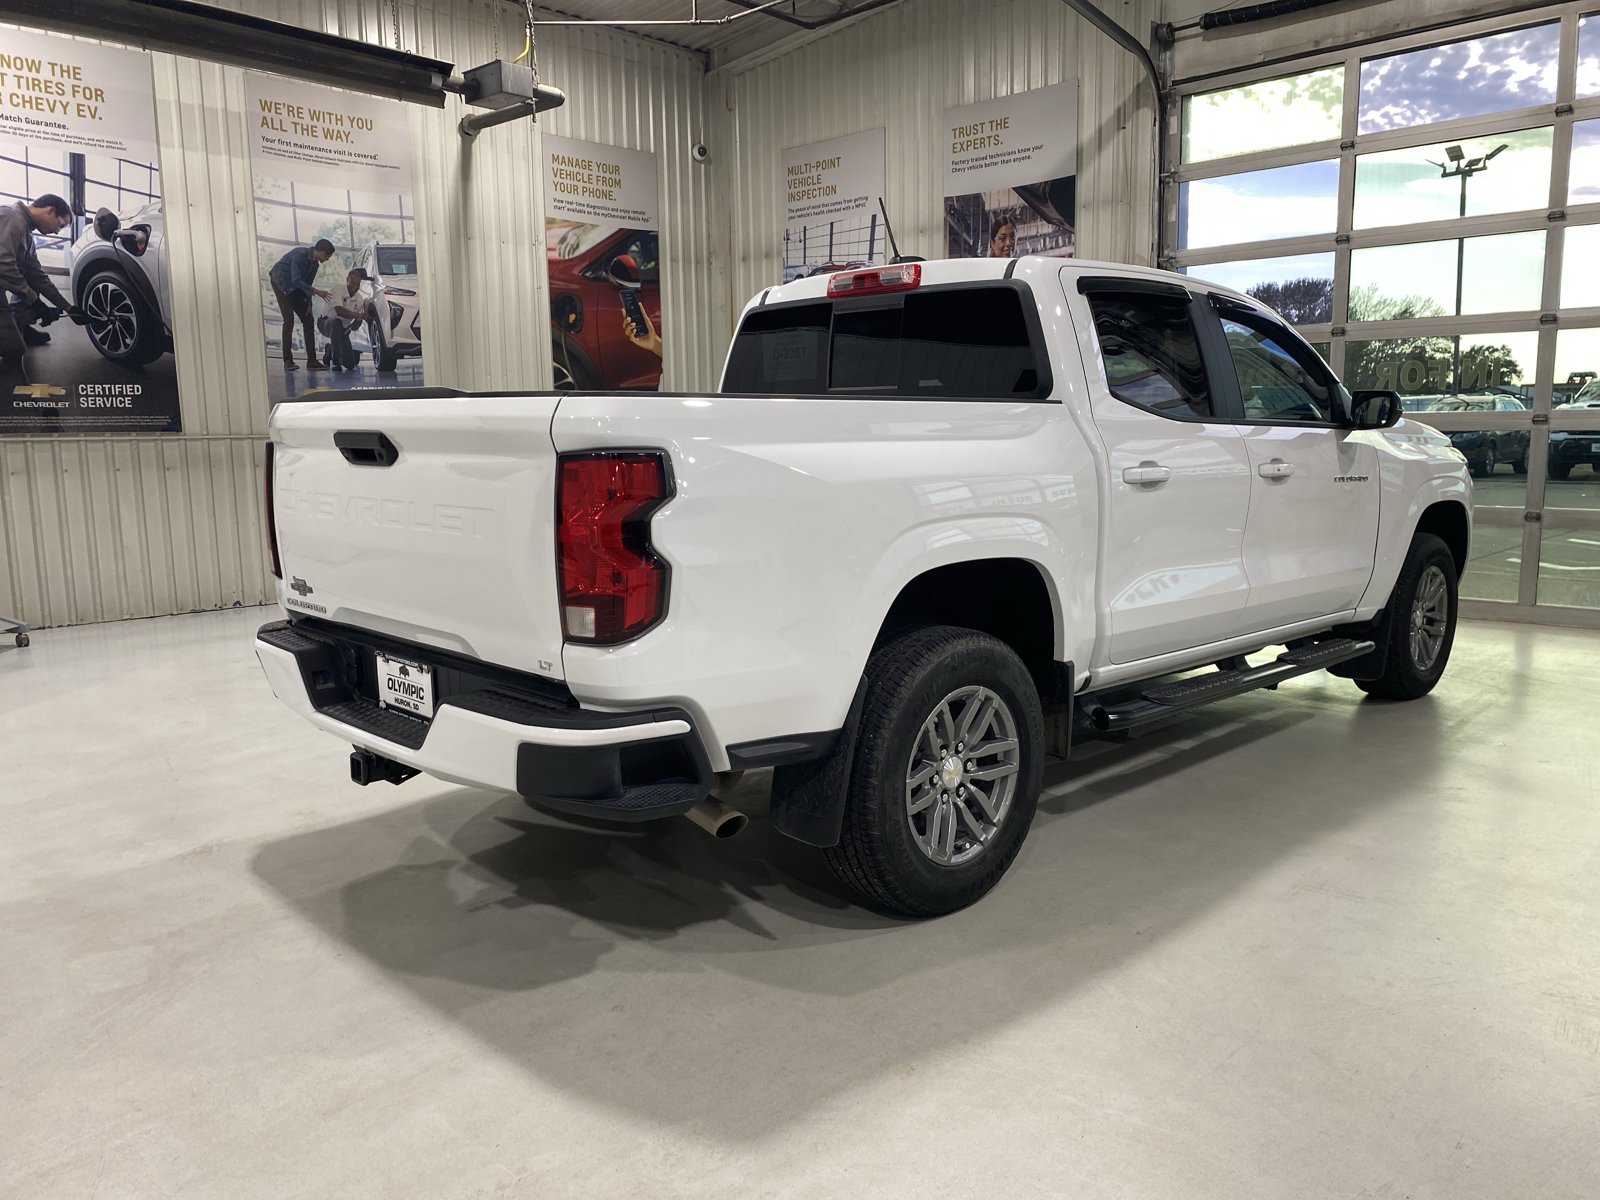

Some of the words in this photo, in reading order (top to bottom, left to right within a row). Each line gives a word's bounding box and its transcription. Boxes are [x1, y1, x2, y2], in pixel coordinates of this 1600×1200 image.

[0, 54, 41, 74] NOW
[48, 62, 82, 81] THE
[13, 75, 65, 96] TIRES
[71, 84, 105, 103] FOR
[9, 92, 69, 115] CHEVY
[76, 103, 103, 121] EV.
[259, 99, 304, 120] WE'RE
[308, 108, 344, 127] WITH
[347, 115, 373, 131] YOU
[25, 117, 69, 130] Guarantee.
[260, 116, 288, 132] ALL
[291, 121, 318, 138] THE
[322, 127, 354, 144] WAY.
[952, 122, 985, 139] TRUST
[988, 117, 1010, 132] THE
[261, 135, 276, 144] Your
[277, 138, 292, 147] first
[293, 142, 332, 154] maintenance
[333, 149, 347, 157] visit
[952, 134, 1003, 154] EXPERTS.
[552, 153, 593, 172] MANAGE
[595, 161, 621, 176] YOUR
[951, 158, 970, 167] Factory
[970, 155, 988, 163] trained
[988, 150, 1017, 160] technicians
[1031, 144, 1044, 153] your
[967, 163, 984, 171] vehicle
[984, 160, 999, 168] better
[1012, 154, 1033, 164] anyone.
[787, 156, 842, 177] MULTI-POINT
[552, 166, 593, 185] VEHICLE
[596, 175, 622, 189] FROM
[787, 174, 822, 190] VEHICLE
[552, 180, 579, 196] YOUR
[581, 186, 617, 201] PHONE.
[787, 184, 837, 203] INSPECTION
[564, 199, 586, 208] real-time
[586, 202, 610, 212] diagnostics
[619, 208, 630, 216] enjoy
[567, 206, 586, 215] available
[627, 214, 641, 222] Mobile
[813, 209, 825, 217] health
[78, 384, 142, 395] CERTIFIED
[80, 396, 133, 408] SERVICE
[537, 659, 553, 672] LT
[387, 677, 424, 701] OLYMPIC
[394, 696, 412, 710] HURON,
[412, 703, 420, 711] SD
